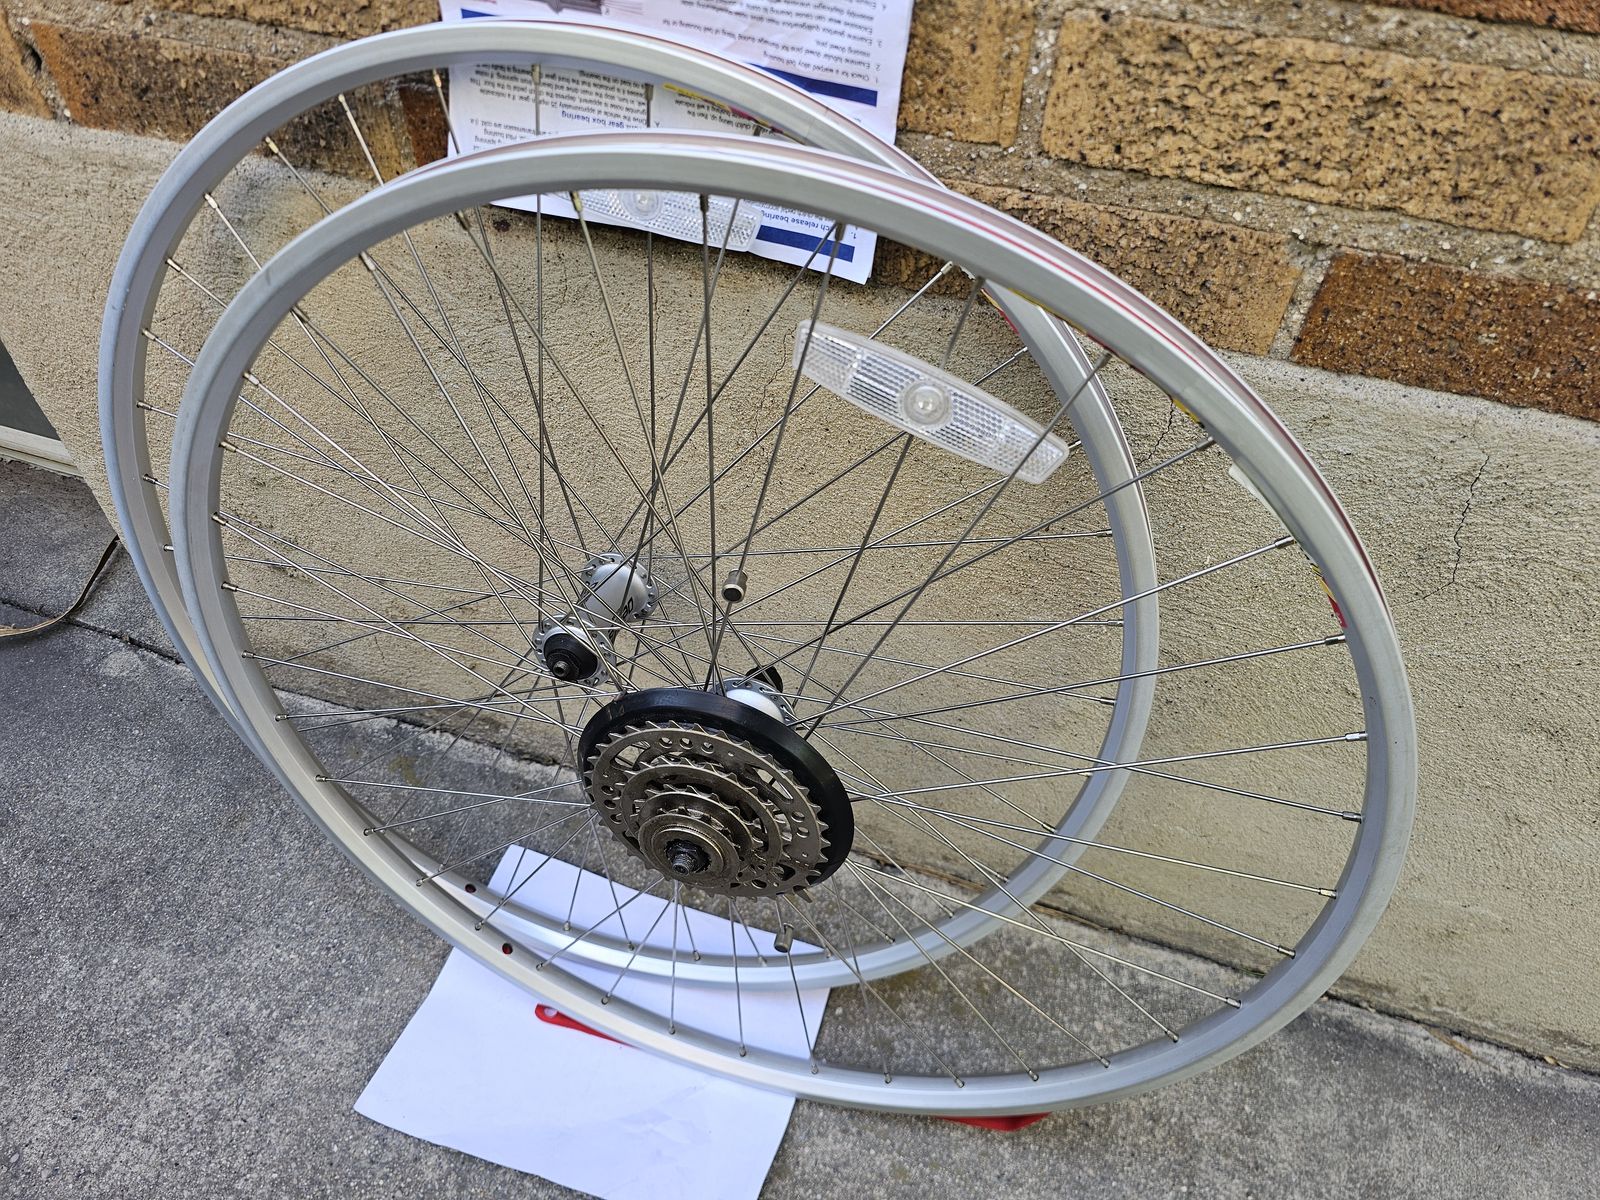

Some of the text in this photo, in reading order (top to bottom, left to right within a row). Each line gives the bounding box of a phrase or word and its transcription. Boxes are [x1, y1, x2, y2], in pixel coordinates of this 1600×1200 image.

[561, 111, 590, 123] bearing
[592, 118, 606, 126] box
[608, 120, 625, 129] gear
[790, 218, 819, 230] release
